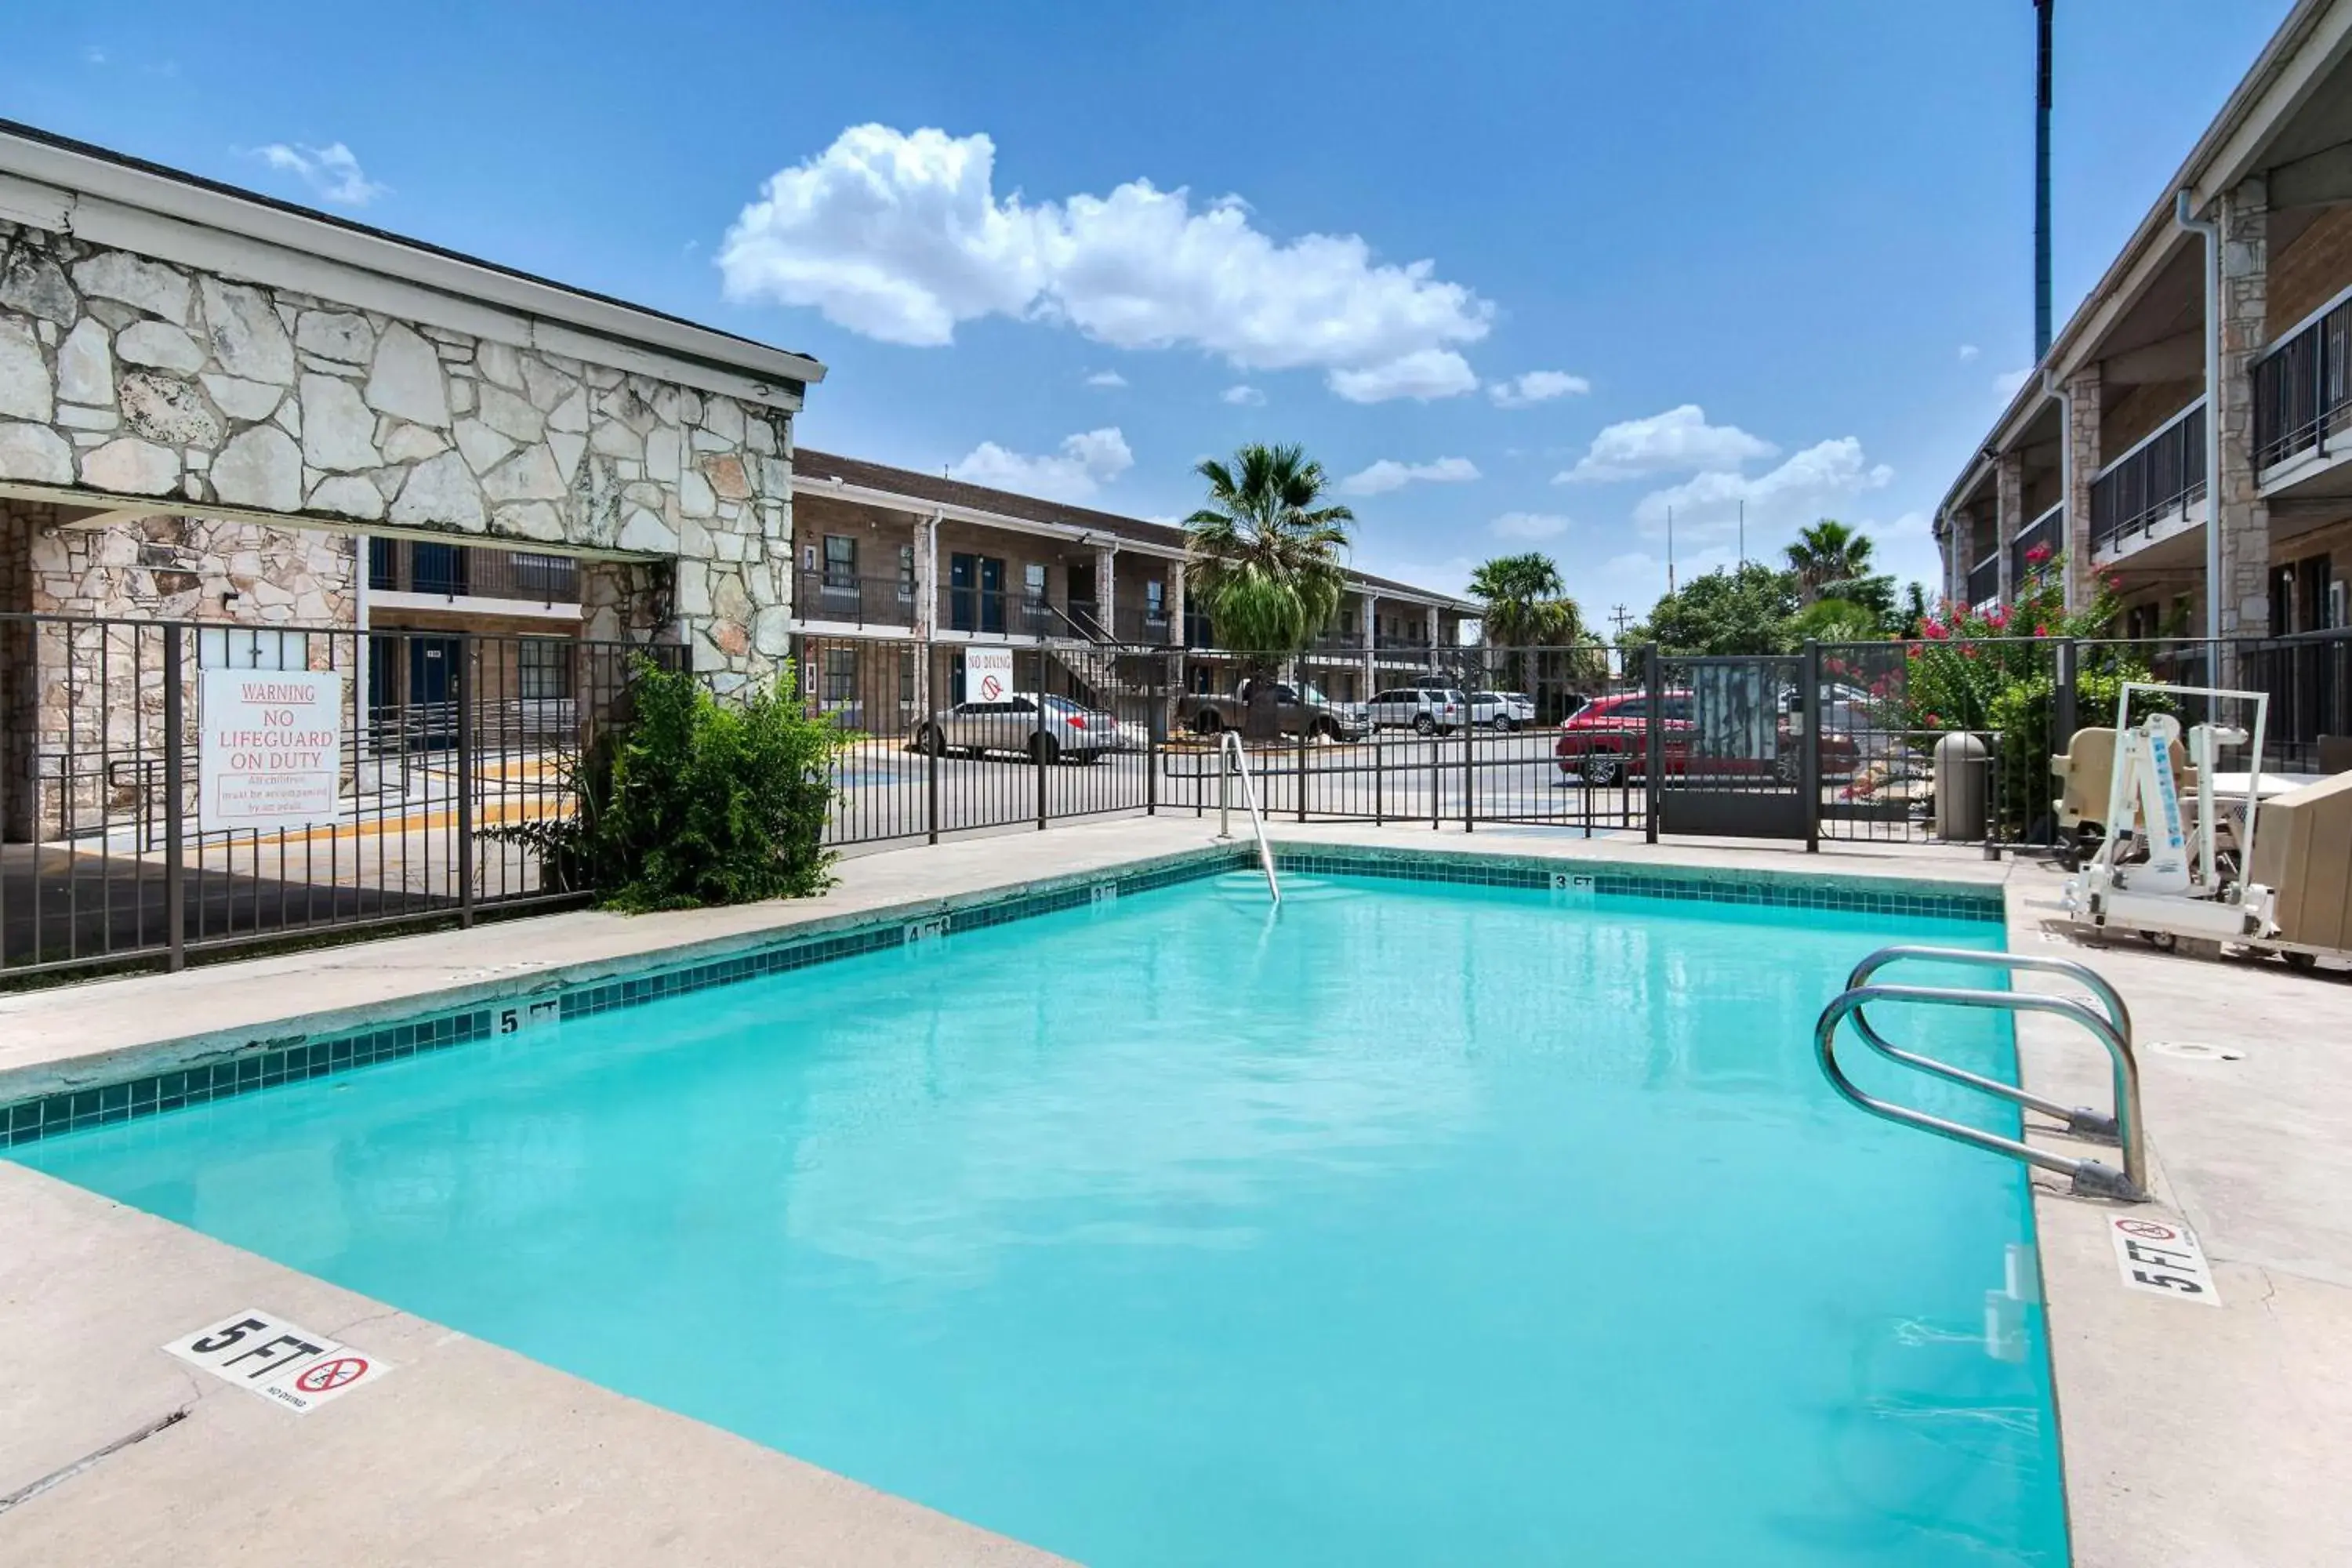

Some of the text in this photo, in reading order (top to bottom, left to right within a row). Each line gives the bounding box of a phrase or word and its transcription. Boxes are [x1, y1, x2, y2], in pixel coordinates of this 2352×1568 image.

[968, 654, 981, 669] NO
[241, 683, 315, 702] WARNING
[263, 710, 295, 727] NO
[220, 731, 333, 748] LIFEGUARD
[230, 752, 322, 770] ON DUTY
[1556, 875, 1566, 889] 3
[501, 1008, 518, 1034] 5
[2125, 1240, 2203, 1293] 5 FT
[191, 1318, 325, 1379] 5 FT
[267, 1386, 281, 1396] NO
